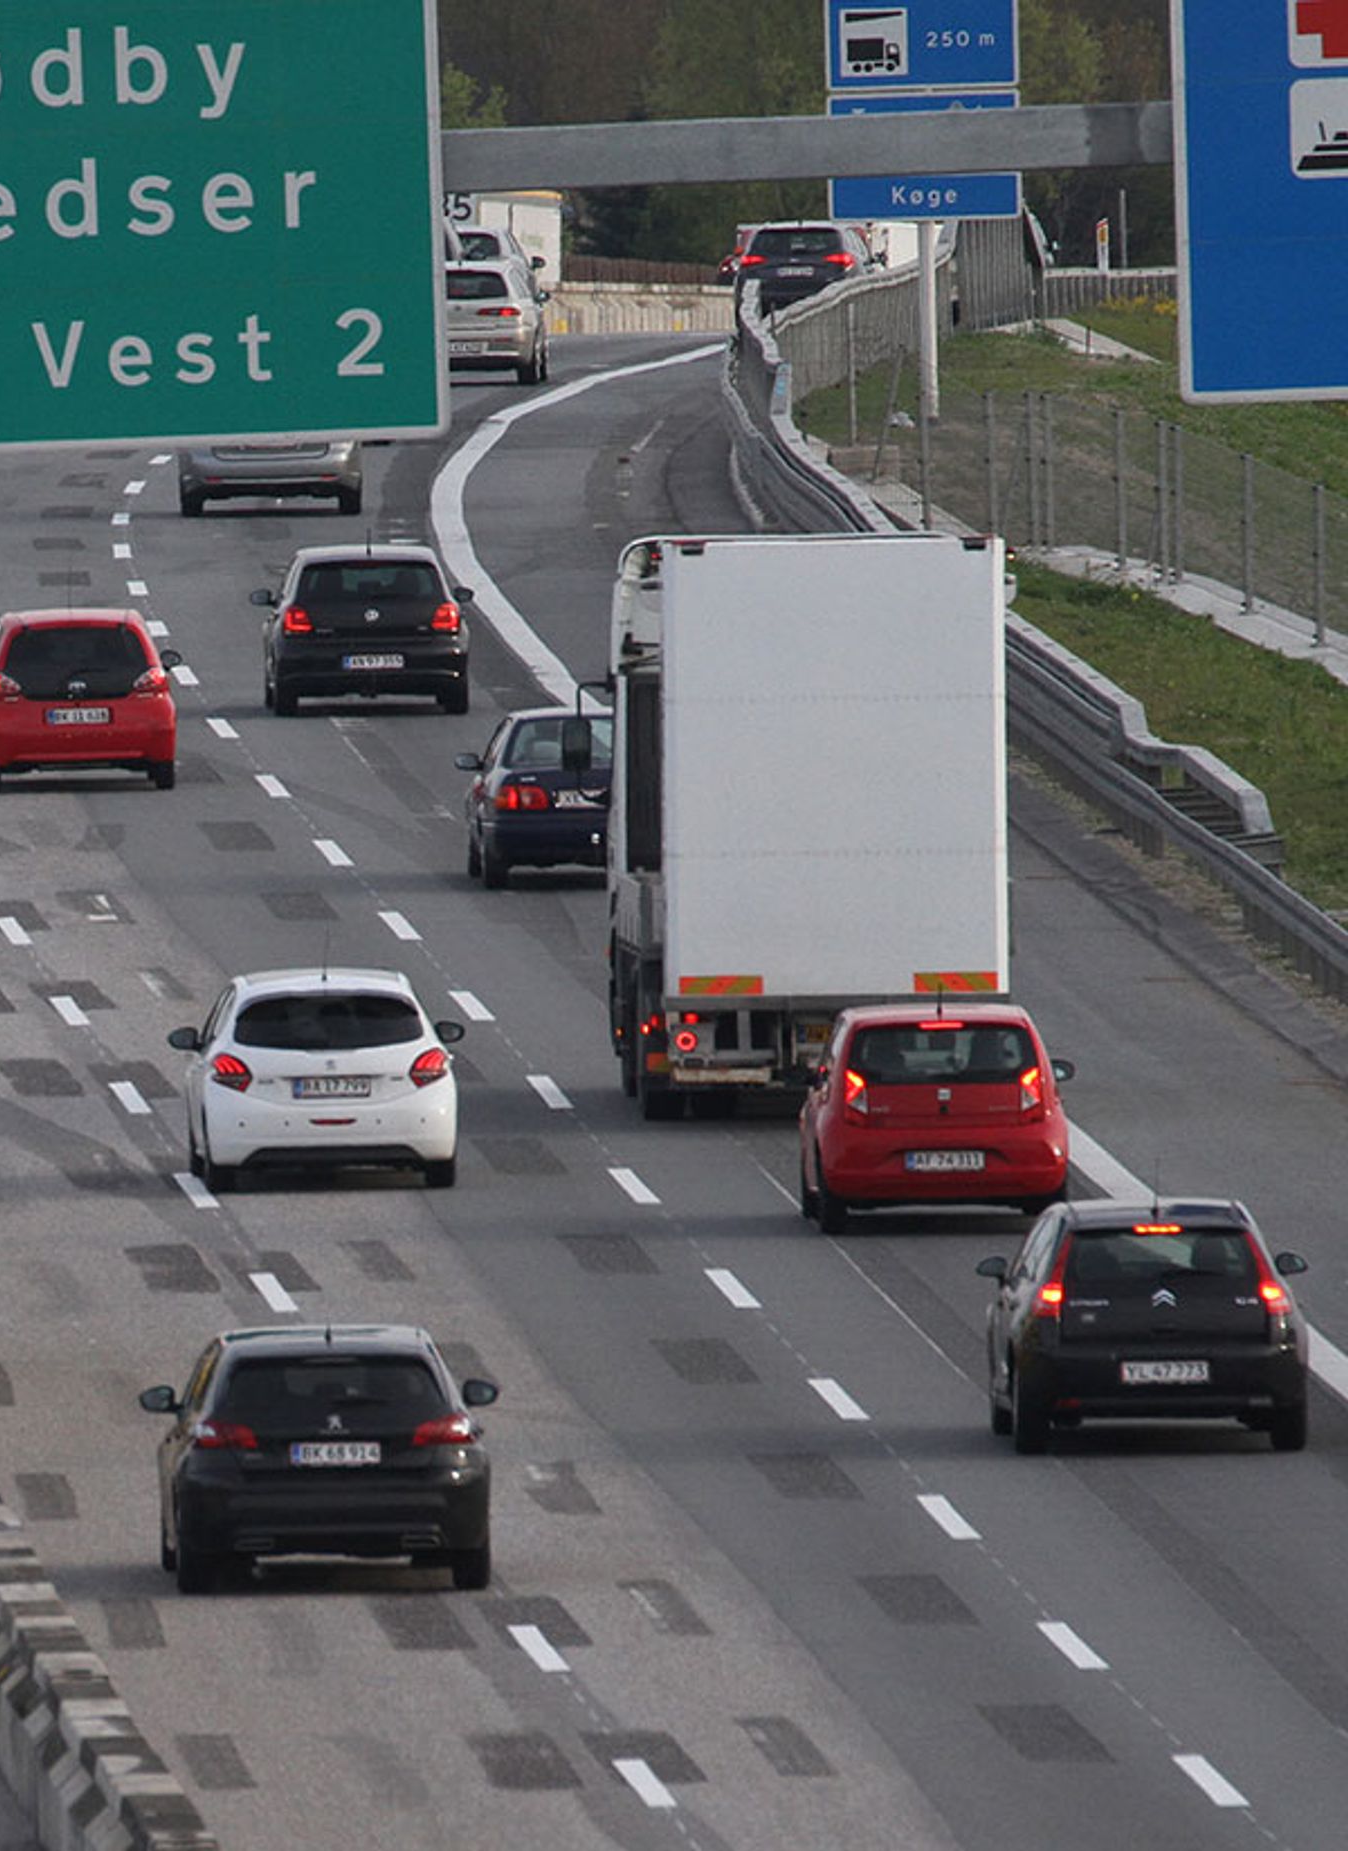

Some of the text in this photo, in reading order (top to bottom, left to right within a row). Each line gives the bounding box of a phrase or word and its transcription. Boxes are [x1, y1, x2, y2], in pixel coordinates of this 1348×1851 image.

[926, 30, 995, 48] 250 m
[891, 186, 958, 208] Køge
[32, 315, 272, 388] Vest
[337, 309, 384, 376] 2
